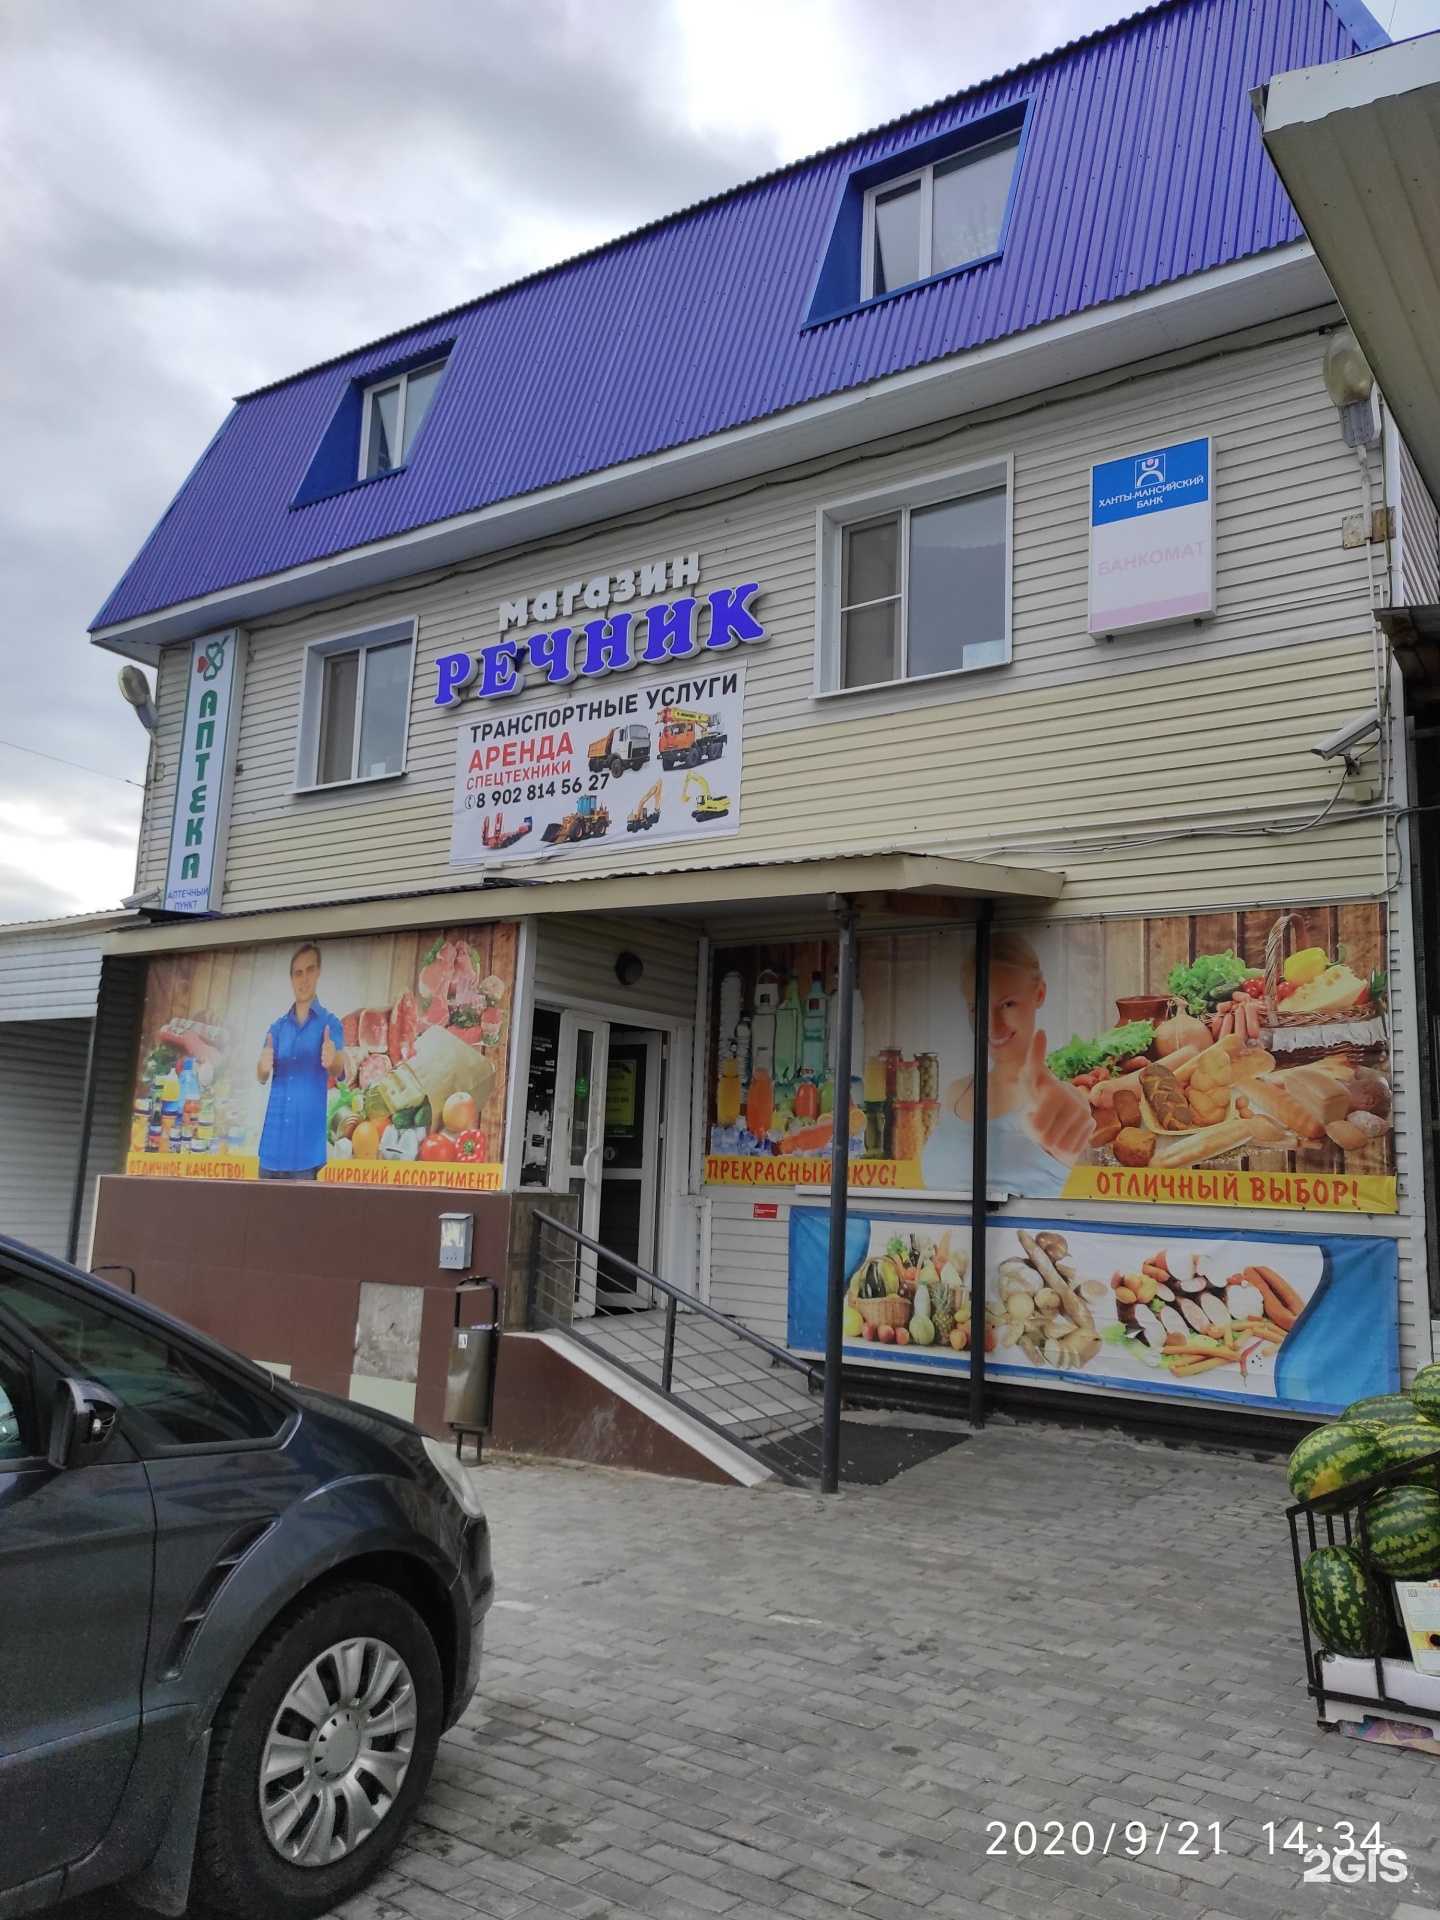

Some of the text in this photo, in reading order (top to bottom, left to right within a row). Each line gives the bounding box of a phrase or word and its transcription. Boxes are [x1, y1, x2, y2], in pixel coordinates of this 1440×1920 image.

[1099, 475, 1204, 508] ХАНТЫ-МАНСИЙСКИЙ
[1136, 495, 1164, 509] БАНК
[1098, 541, 1208, 576] БАНКОМАТ
[433, 582, 767, 707] РЕЧНИК
[471, 672, 738, 744] ТРАНСПОРТНЫЕ УСЛУГИ
[468, 731, 574, 774] АРЕНДА
[180, 689, 218, 881] АПТЕКА
[466, 759, 571, 791] СПЕЦТЕХНИКИ
[476, 773, 610, 809] 8 902 814 56 27
[186, 1161, 246, 1179] КАЧЕСТВО!
[324, 1165, 500, 1190] ШИРОКИЙ АССОРТИМЕНТ!
[707, 1159, 897, 1186] ПРЕКРАСНЫЙ КУС!
[1096, 1172, 1358, 1206] ОТЛИЧНЫЙ ВЫБОР!
